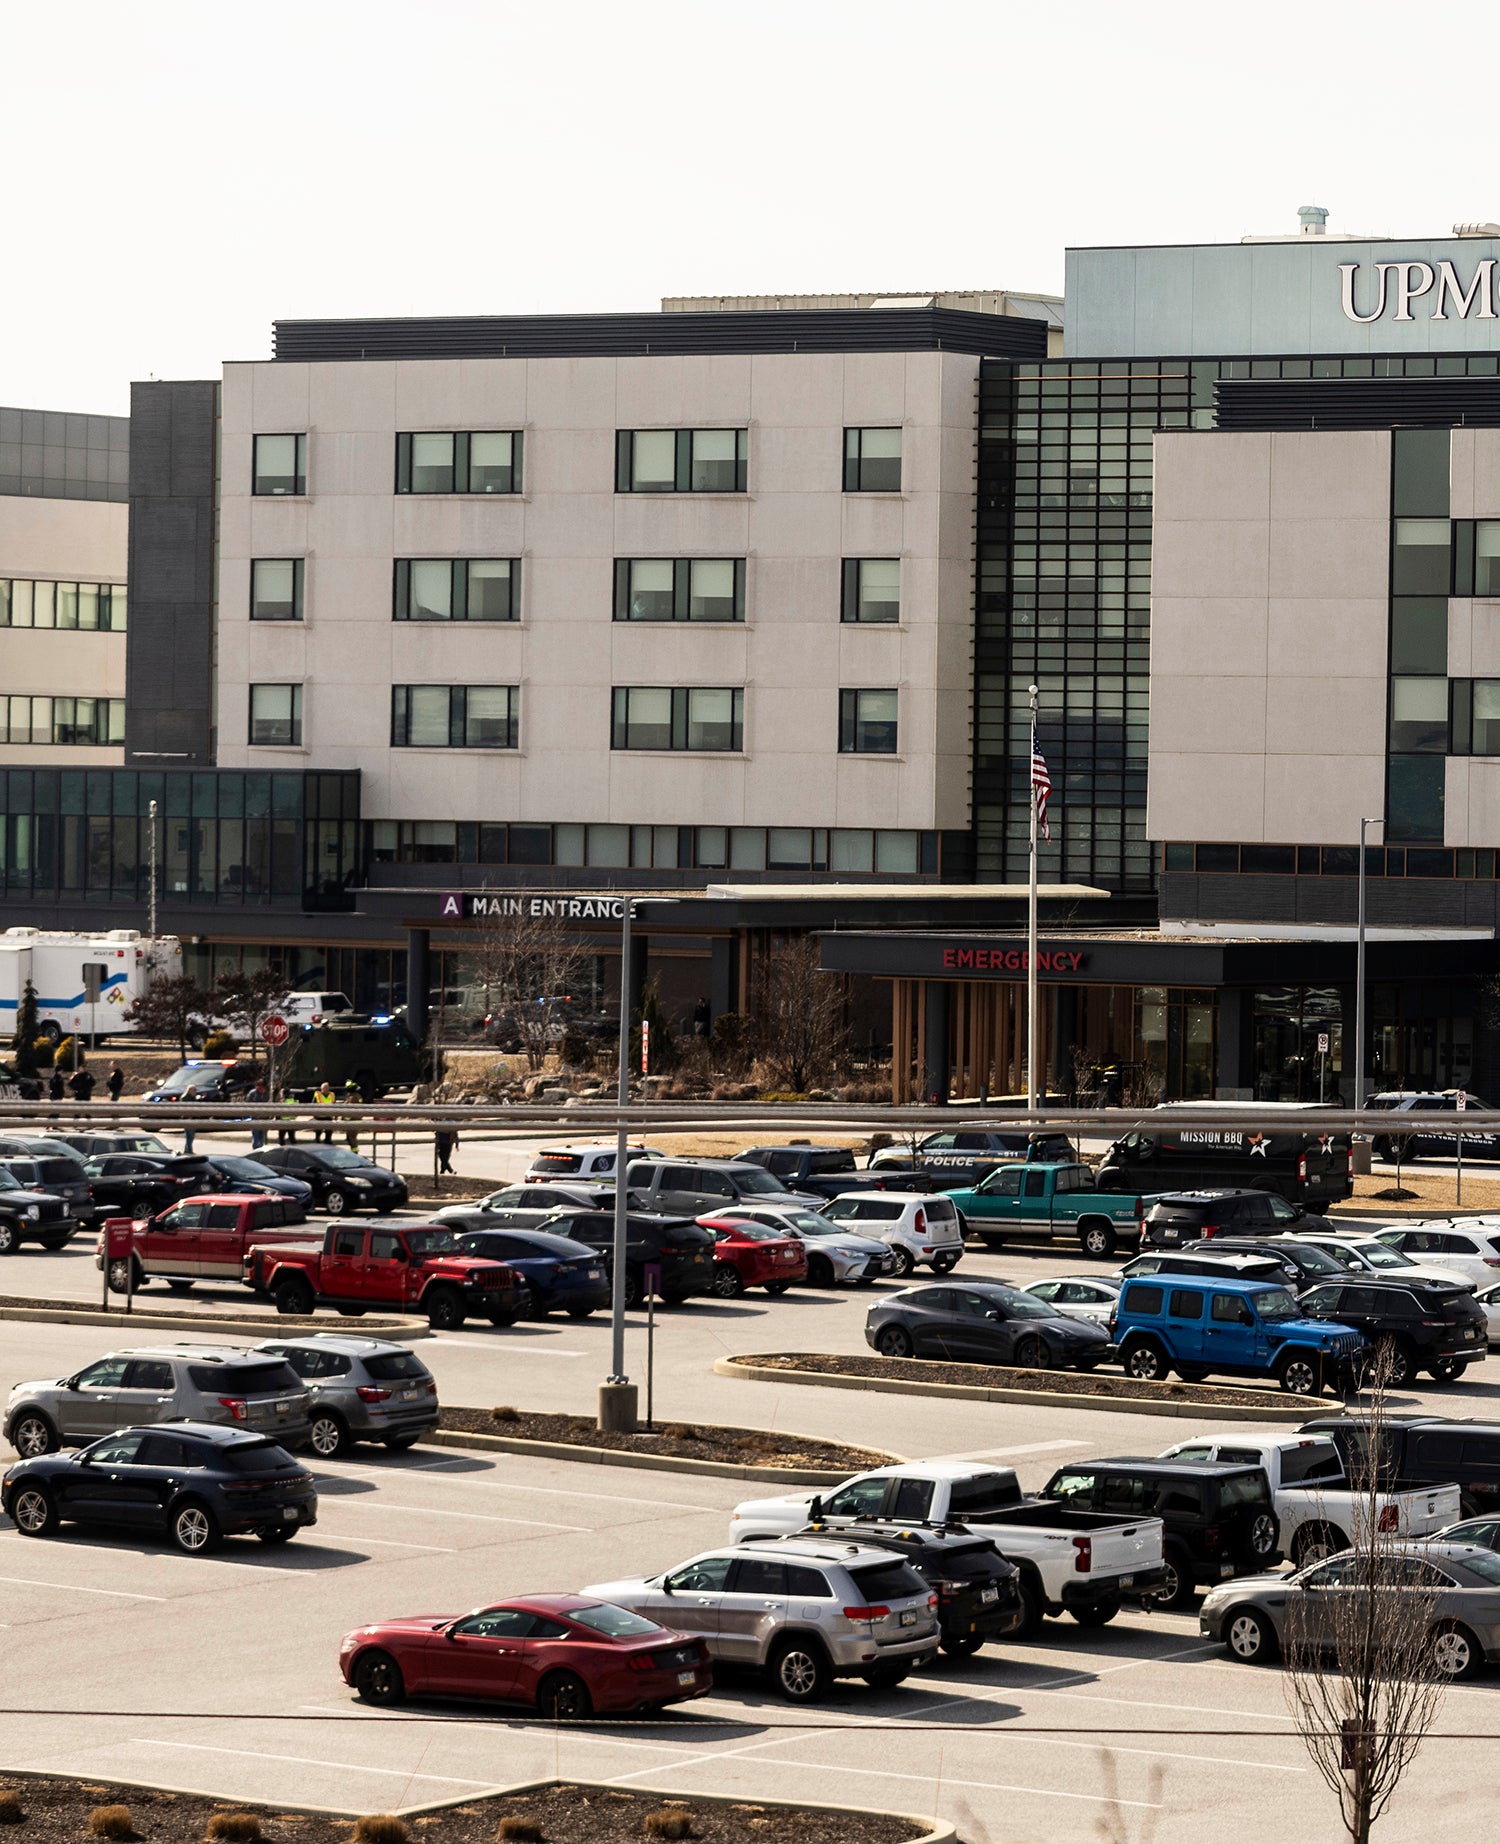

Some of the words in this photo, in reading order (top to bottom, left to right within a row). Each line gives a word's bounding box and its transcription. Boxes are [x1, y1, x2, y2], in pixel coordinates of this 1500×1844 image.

[443, 896, 459, 914] A
[473, 898, 523, 915] MAIN
[530, 899, 637, 919] ENTRANCE
[943, 949, 1083, 971] EMERGENCY
[263, 1024, 287, 1036] STOP
[1180, 1131, 1221, 1143] MISSION
[1224, 1131, 1243, 1145] BBQ
[924, 1156, 975, 1166] POLICE
